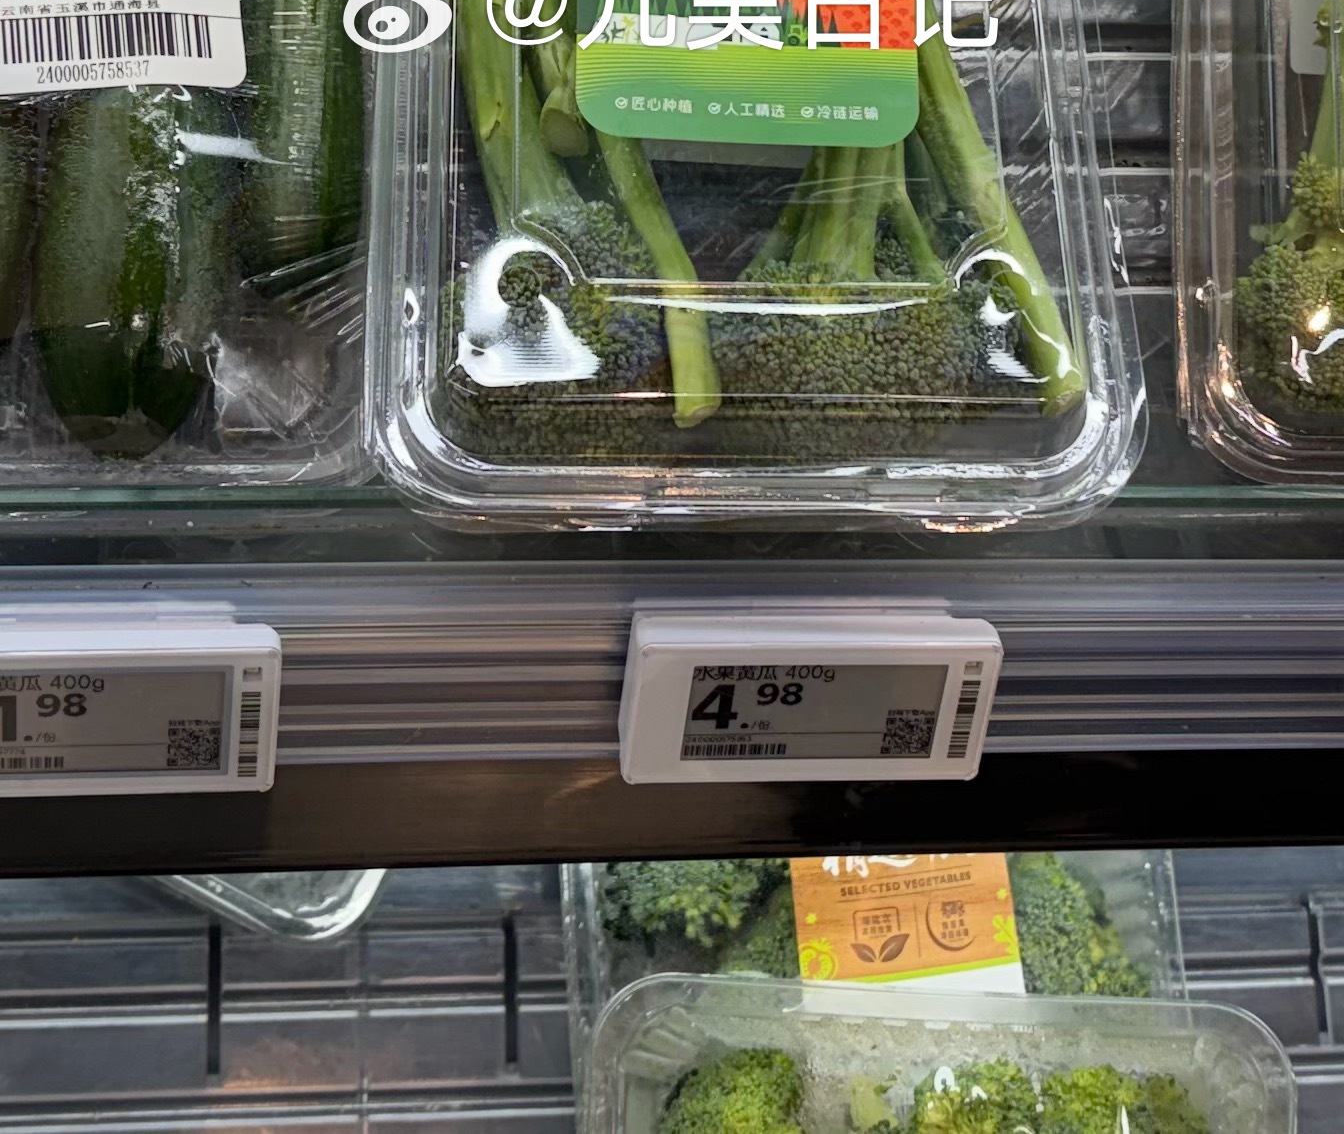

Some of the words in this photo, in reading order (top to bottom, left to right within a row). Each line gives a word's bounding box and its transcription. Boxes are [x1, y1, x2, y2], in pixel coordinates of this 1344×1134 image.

[36, 60, 150, 84] 2400005758537
[632, 96, 693, 114] 匠心种植
[724, 102, 785, 118] 人工精选
[817, 105, 879, 121] 冷链运输
[694, 665, 777, 681] 水果黄瓜
[784, 665, 835, 682] 400g
[49, 674, 105, 693] 400g
[840, 880, 901, 898] SELECTED
[903, 870, 972, 889] VEGETABLES
